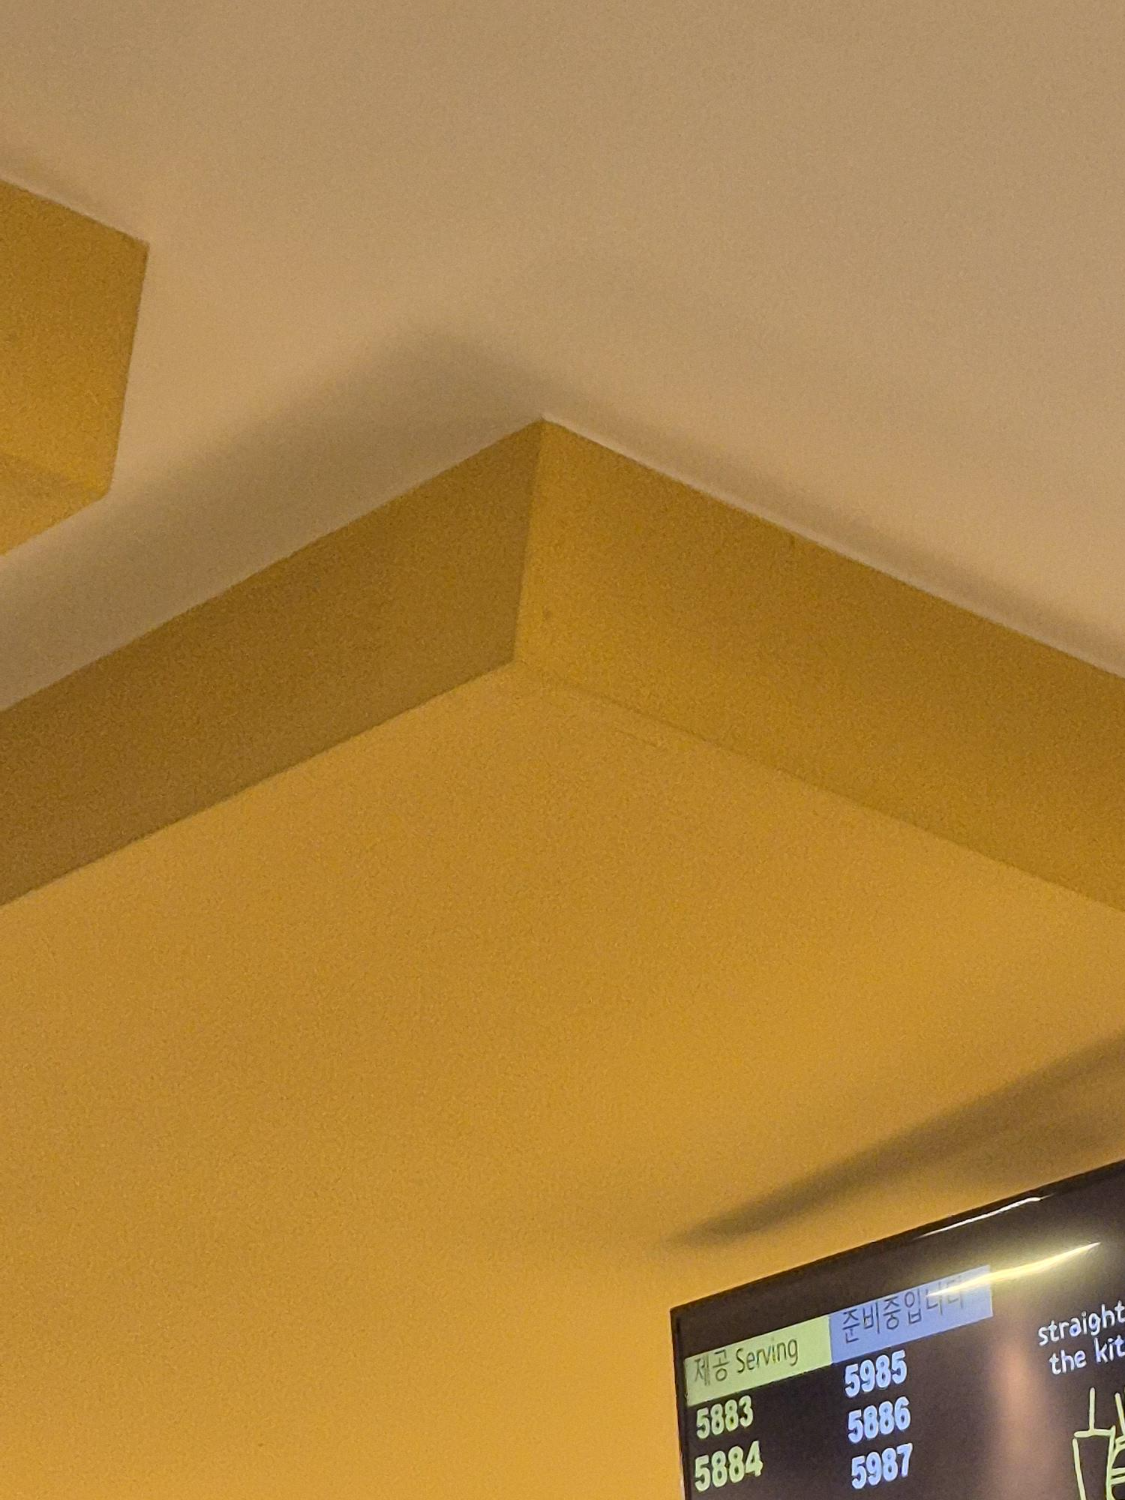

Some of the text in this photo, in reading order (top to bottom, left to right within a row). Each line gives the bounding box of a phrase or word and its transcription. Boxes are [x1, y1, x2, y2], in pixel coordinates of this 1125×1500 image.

[694, 1338, 799, 1386] 제공 Serving
[844, 1350, 907, 1398] 5985
[1049, 1349, 1087, 1375] the
[696, 1395, 754, 1440] 5883
[847, 1396, 912, 1444] 5886
[694, 1440, 764, 1492] 5884
[851, 1443, 913, 1490] 5987
